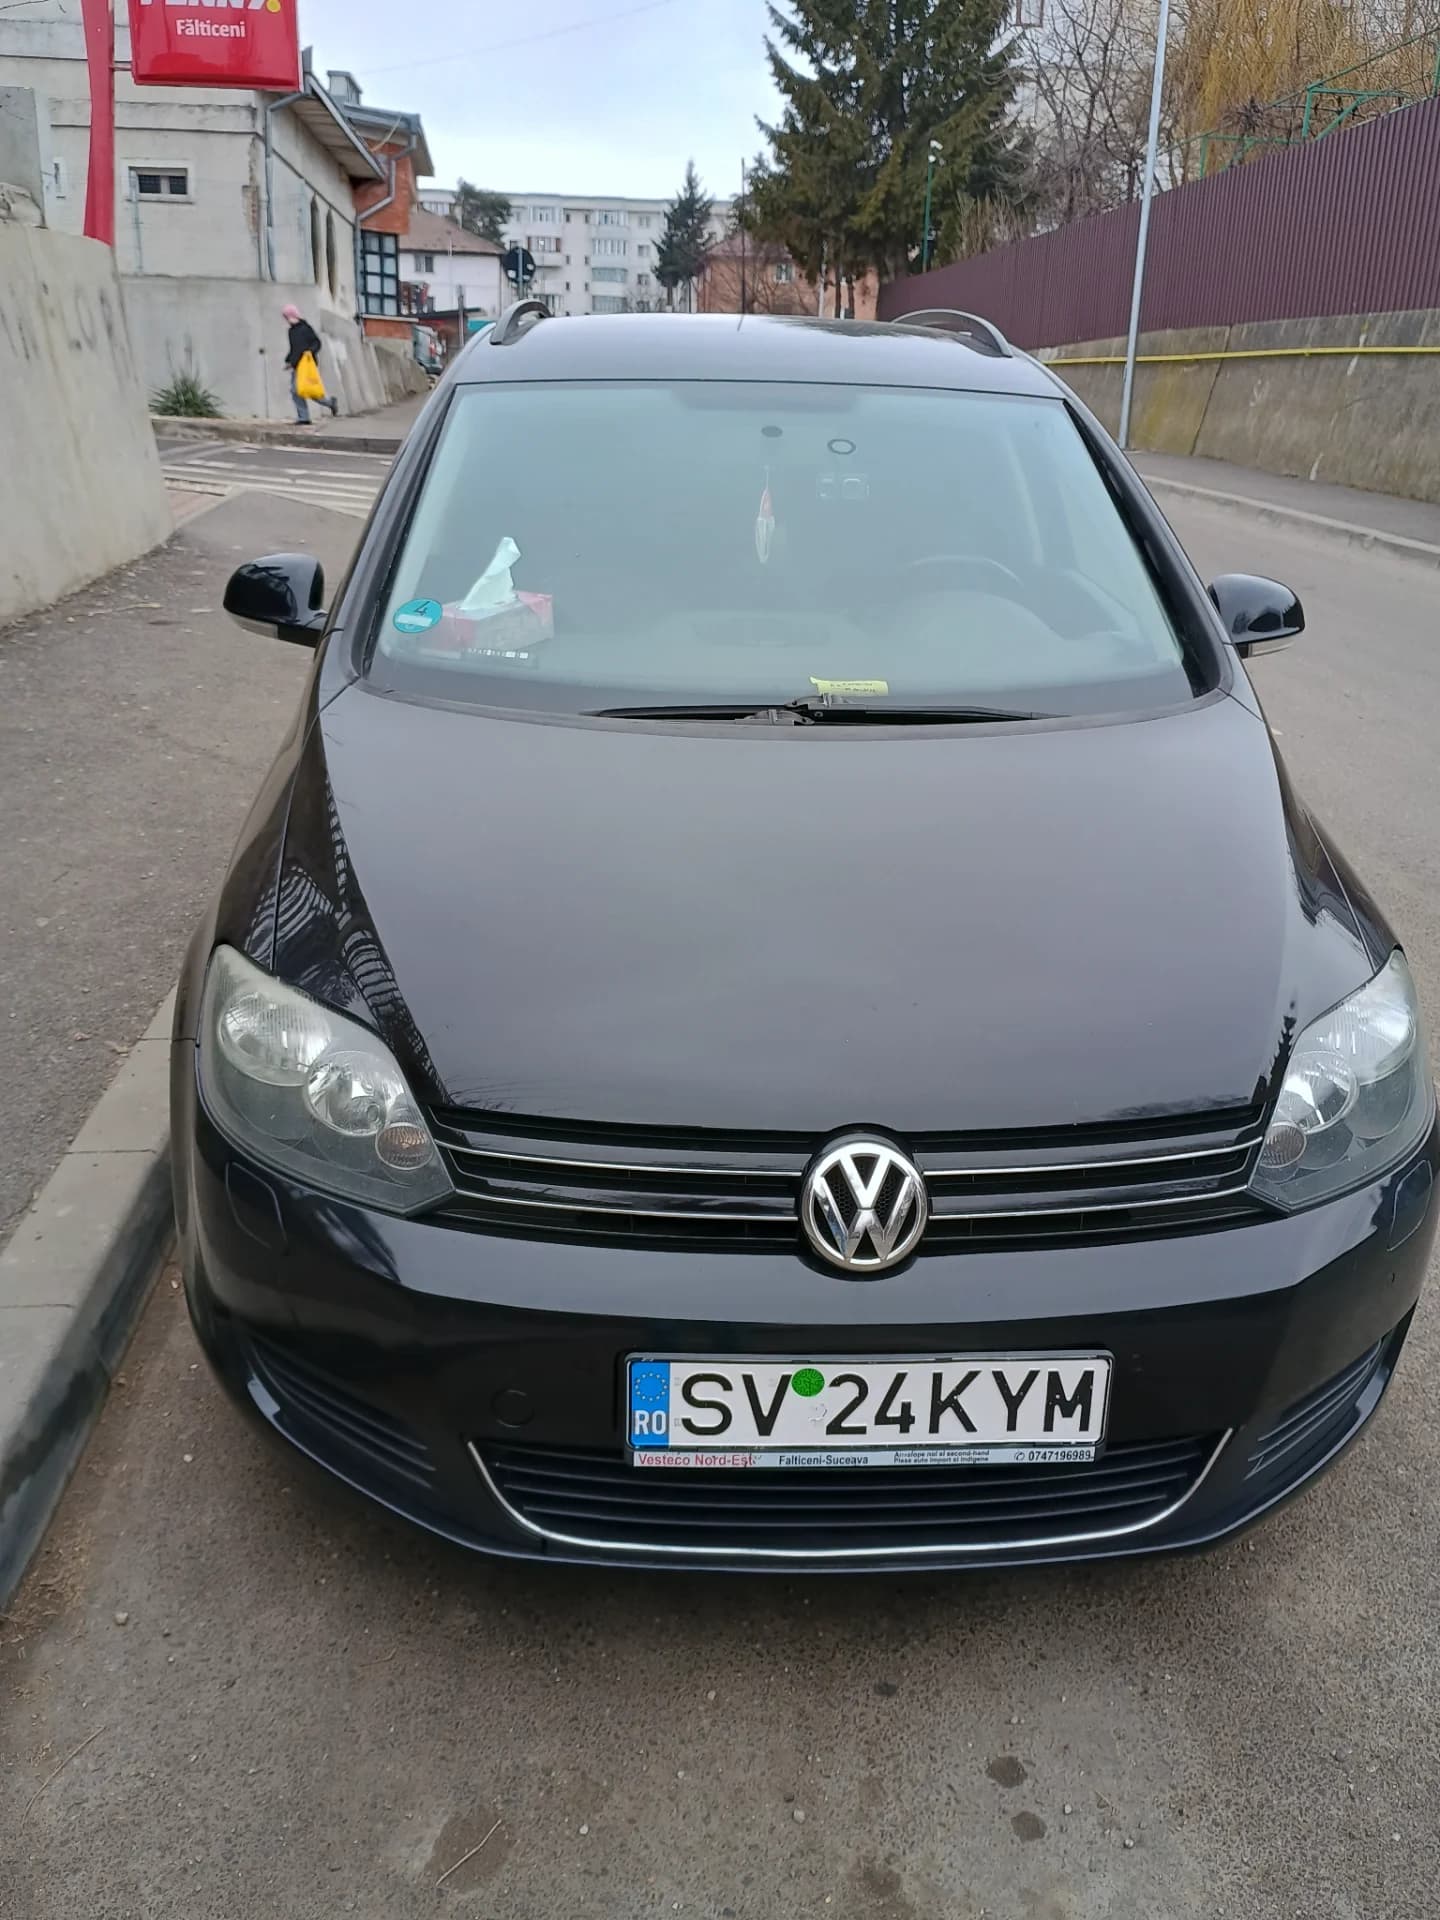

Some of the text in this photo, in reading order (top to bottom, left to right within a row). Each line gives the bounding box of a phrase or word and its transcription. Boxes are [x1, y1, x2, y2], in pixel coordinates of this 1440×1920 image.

[176, 18, 246, 38] Fălticeni
[681, 1372, 793, 1437] SV
[633, 1409, 667, 1436] RO
[638, 1453, 753, 1467] Vesteco Nord-Est
[779, 1454, 869, 1465] Falticeni-Suceava
[1028, 1450, 1092, 1461] 0747196989
